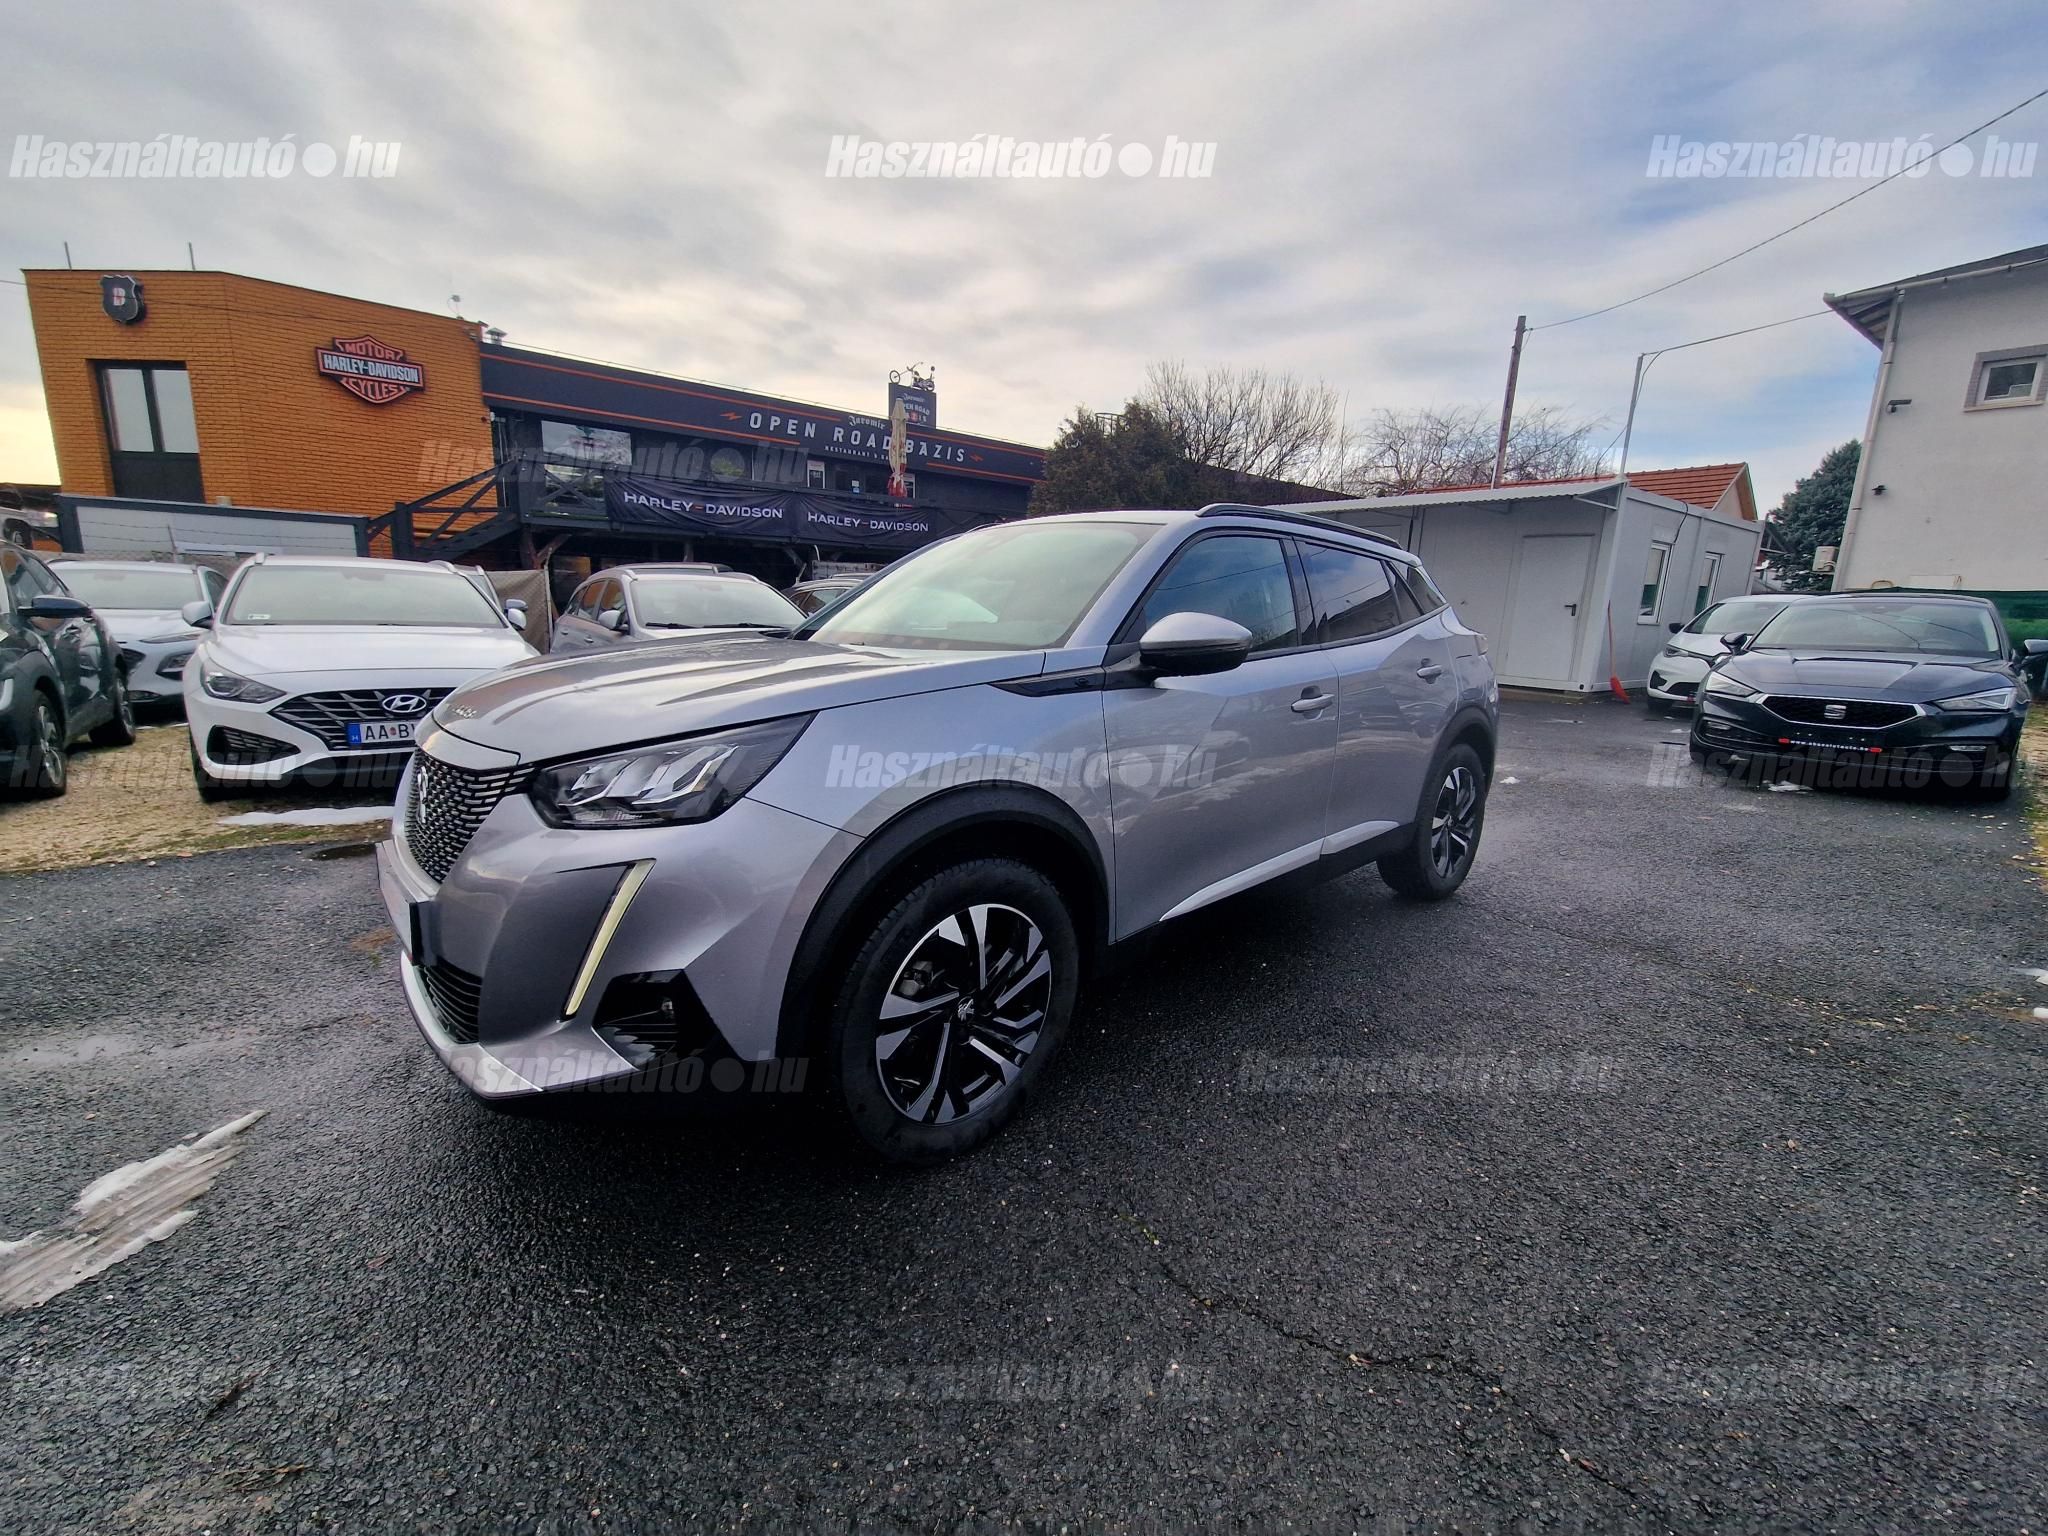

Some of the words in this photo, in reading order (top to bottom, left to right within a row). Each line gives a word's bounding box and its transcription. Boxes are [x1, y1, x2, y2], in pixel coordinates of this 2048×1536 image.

[344, 341, 396, 361] MOTOR
[323, 353, 419, 383] HARLEY-DAVIDSON
[348, 377, 398, 400] CYCLES
[749, 412, 817, 438] OPEN
[833, 426, 892, 451] ROAD
[824, 445, 870, 458] RESTAURANT
[623, 491, 783, 519] HARLEY-DAVIDSON
[807, 511, 929, 532] HARLEY-DAVIDSON
[365, 725, 389, 741] AA
